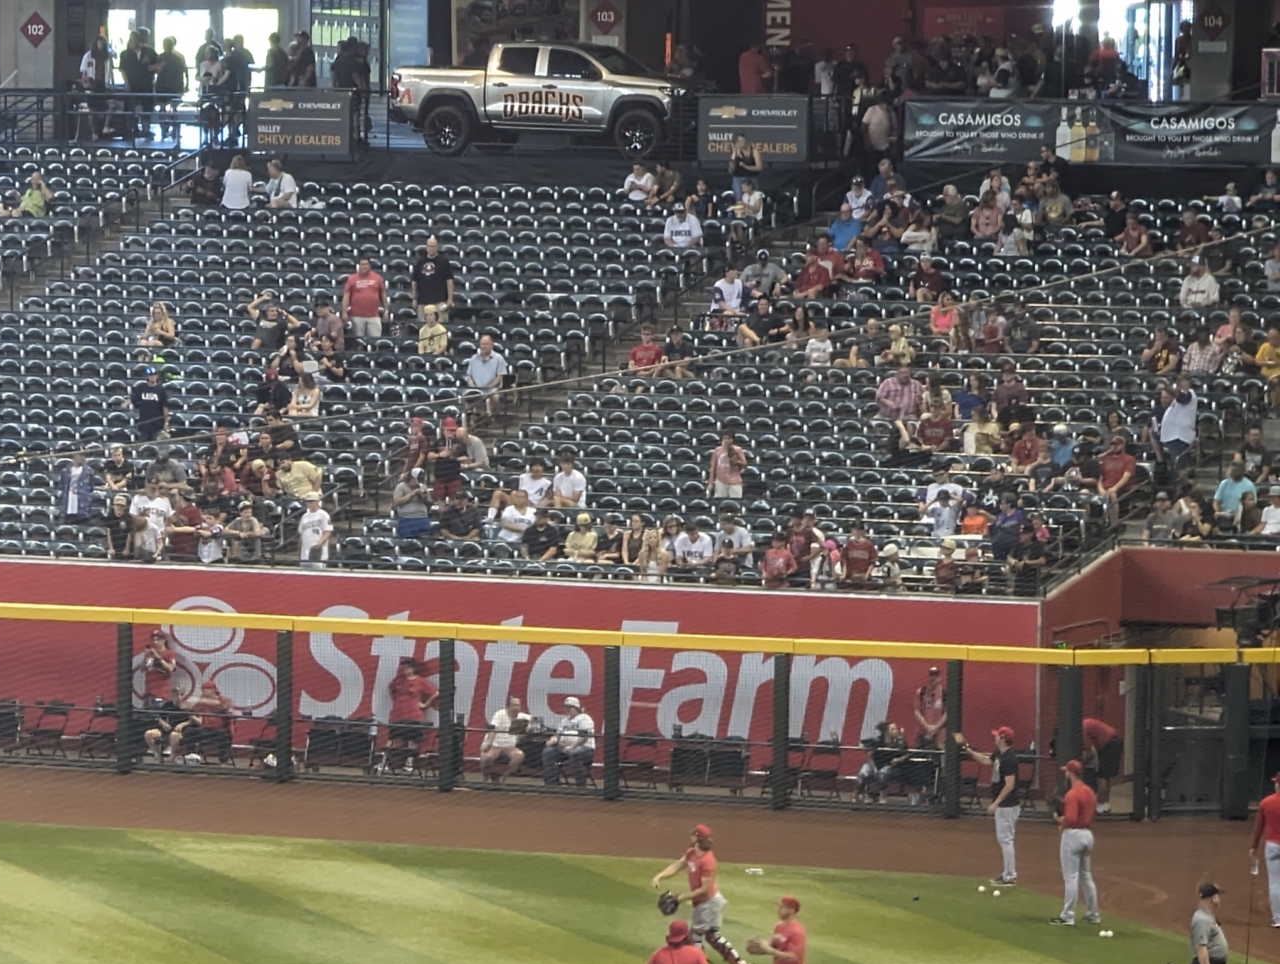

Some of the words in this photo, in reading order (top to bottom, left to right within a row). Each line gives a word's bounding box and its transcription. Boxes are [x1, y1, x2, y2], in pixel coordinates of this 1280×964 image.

[597, 12, 614, 22] 103
[1204, 16, 1222, 27] 104
[27, 25, 44, 36] 102
[752, 109, 797, 117] CHEVROLET
[938, 113, 1022, 126] CASAMIGOS
[1150, 117, 1236, 130] CASAMIGOS
[257, 125, 281, 133] VALLEY
[258, 134, 292, 145] CHEVY
[294, 135, 341, 146] DEALERS
[708, 132, 733, 141] VALLEY
[1126, 134, 1156, 142] BROUGHT
[300, 605, 593, 725] State
[620, 620, 893, 743] Farm
